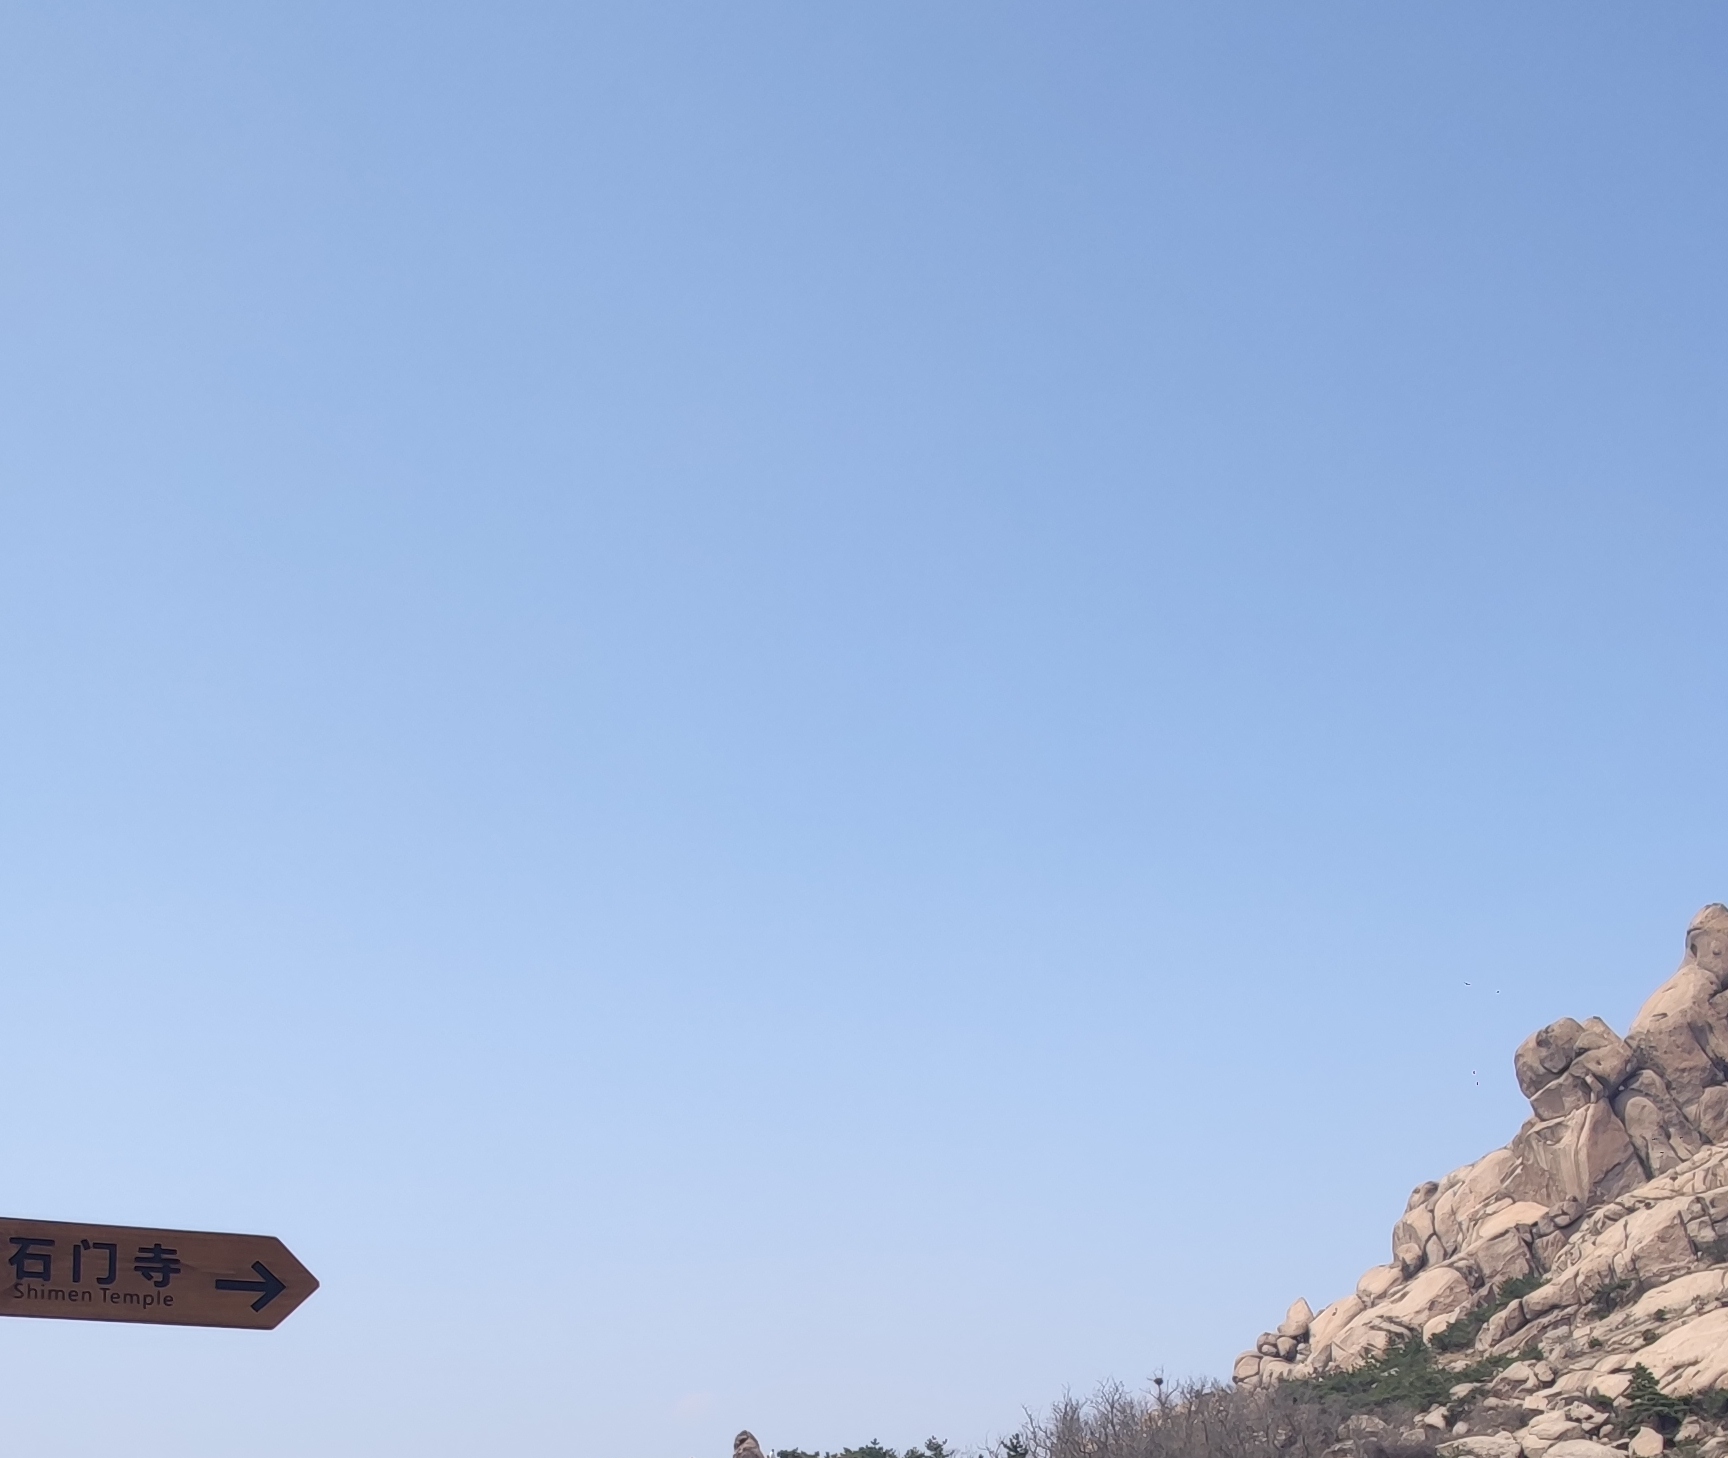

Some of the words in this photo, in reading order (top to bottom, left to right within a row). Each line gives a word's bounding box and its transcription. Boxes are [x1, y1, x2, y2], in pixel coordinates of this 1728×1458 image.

[9, 1236, 182, 1288] 石门寺
[13, 1282, 93, 1302] Shimen
[100, 1286, 175, 1310] Temple
